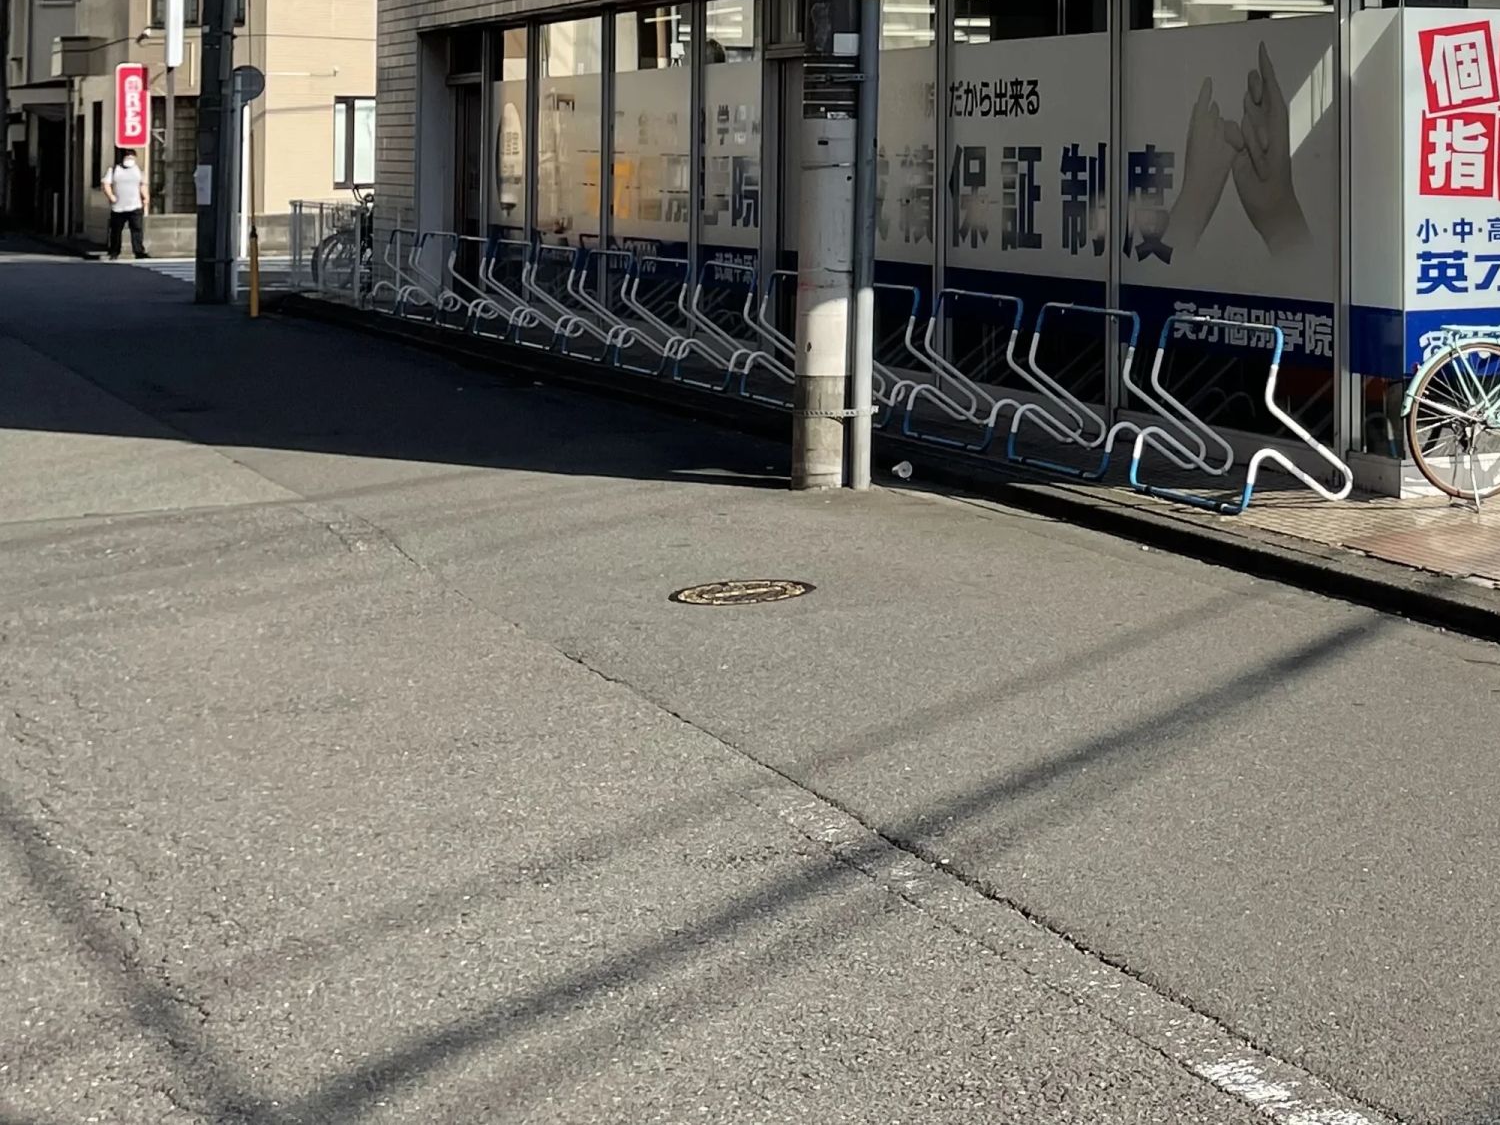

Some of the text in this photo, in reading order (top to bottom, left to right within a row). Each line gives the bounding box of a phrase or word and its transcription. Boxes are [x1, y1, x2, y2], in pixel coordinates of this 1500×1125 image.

[949, 78, 1040, 118] だから出来る
[1173, 300, 1333, 357] 英才個別学院
